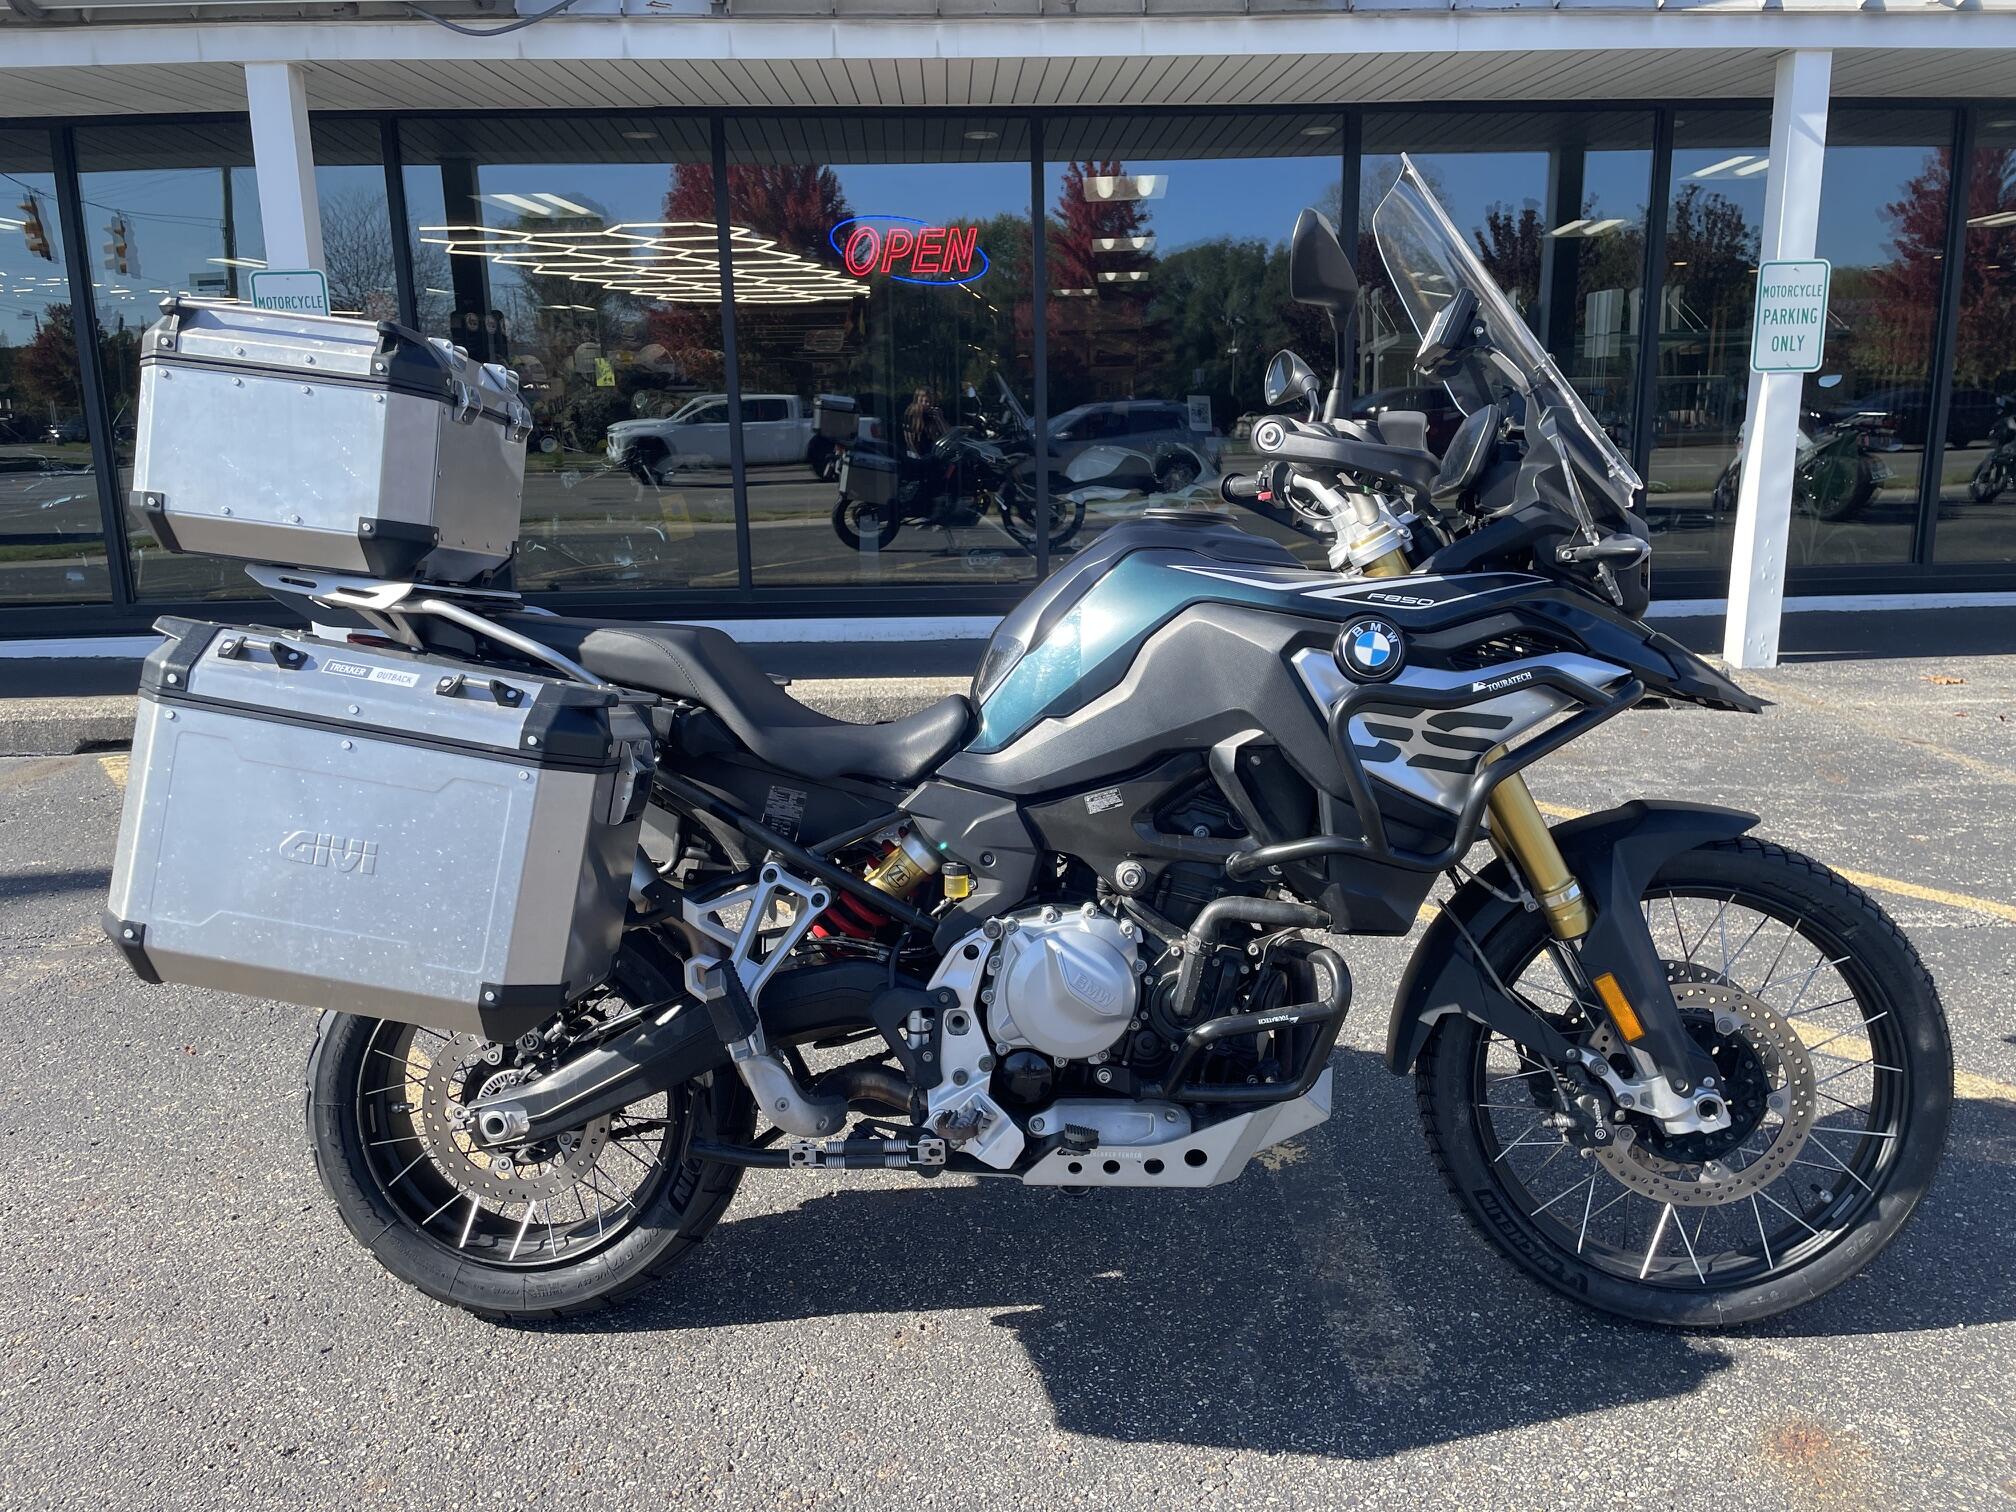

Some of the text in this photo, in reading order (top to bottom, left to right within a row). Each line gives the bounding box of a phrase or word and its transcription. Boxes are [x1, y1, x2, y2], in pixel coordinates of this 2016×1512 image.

[845, 226, 978, 276] OPEN
[1762, 284, 1824, 299] MOTORCYCLE
[257, 295, 324, 310] MOTORCYCLE
[1763, 307, 1819, 326] PARKING
[1771, 334, 1806, 352] ONLY
[1367, 592, 1435, 607] F850
[1351, 622, 1398, 644] BMW
[328, 661, 414, 685] TREKKER OUTBACK
[1486, 671, 1533, 692] TOURATECH
[279, 830, 379, 876] GIVI
[1073, 974, 1118, 1008] BMW
[1592, 1098, 1604, 1128] brembo
